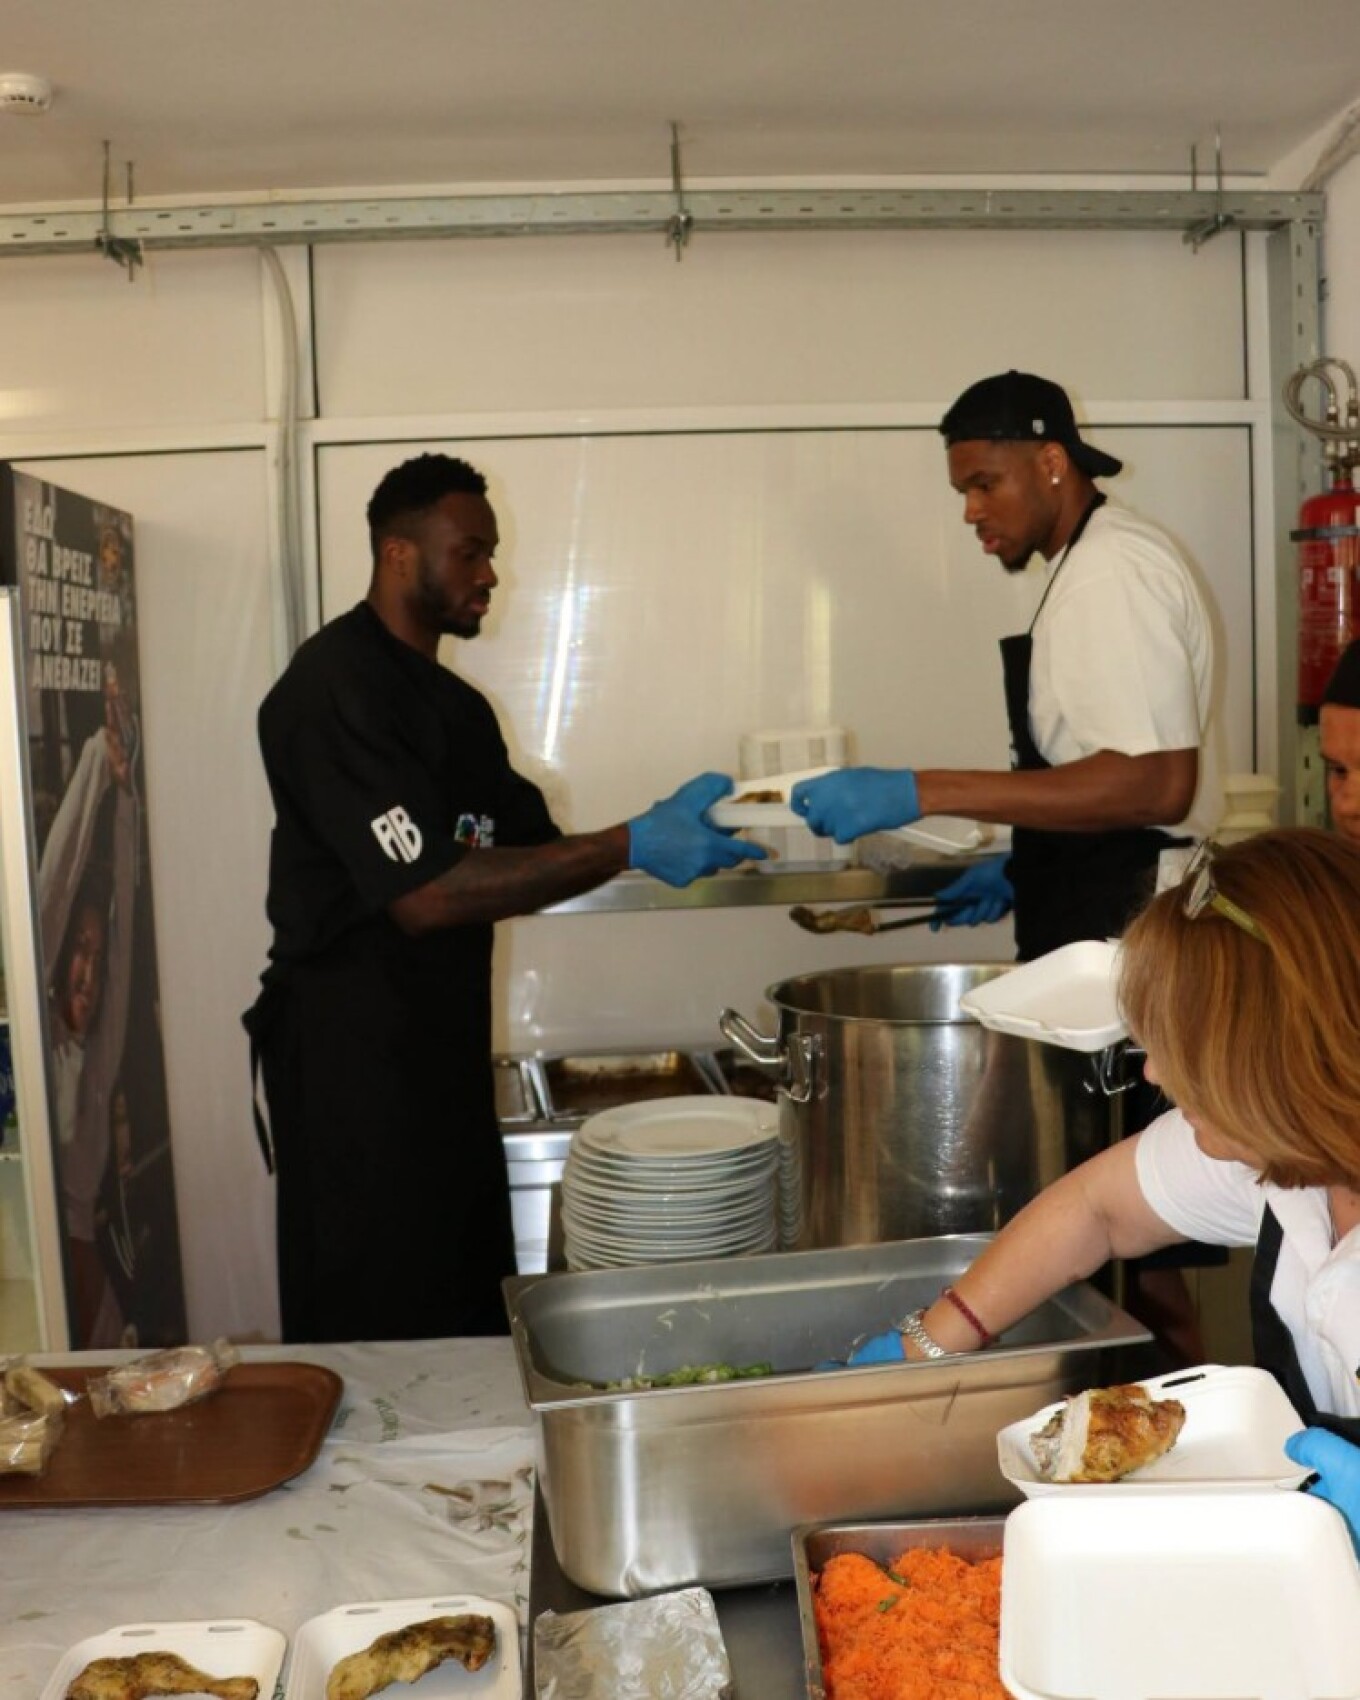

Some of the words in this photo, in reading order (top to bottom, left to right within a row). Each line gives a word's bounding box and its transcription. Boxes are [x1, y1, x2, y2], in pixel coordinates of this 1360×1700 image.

[26, 537, 48, 575] ΘΑ
[52, 544, 93, 586] ΒΡΕΙΣ
[28, 577, 59, 614] ΤΗΝ
[29, 616, 61, 652] ΠΟΥ
[66, 621, 83, 656] ΣΕ
